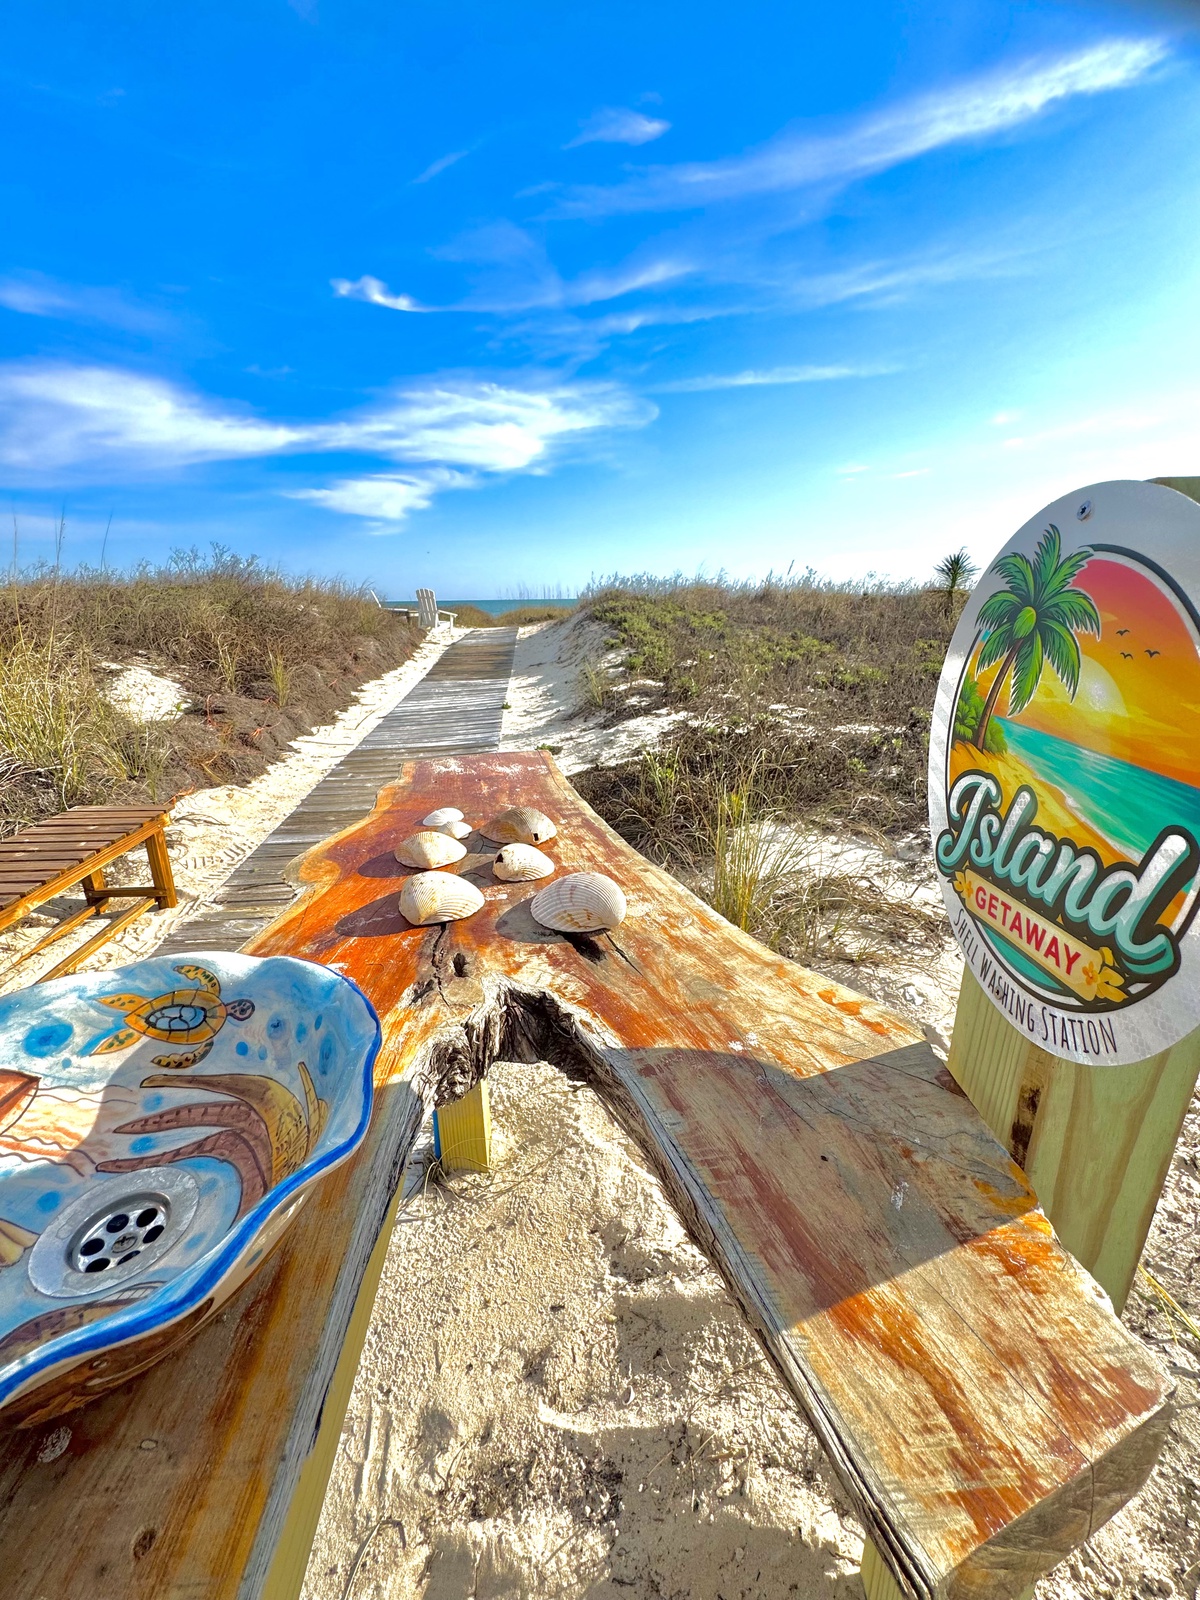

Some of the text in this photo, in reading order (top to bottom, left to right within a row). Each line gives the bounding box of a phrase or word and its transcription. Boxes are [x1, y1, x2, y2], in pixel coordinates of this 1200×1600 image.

[937, 774, 1191, 974] Island
[975, 885, 1081, 976] GETAWAY
[953, 908, 979, 966] SHELL
[1041, 1006, 1118, 1056] STATION
